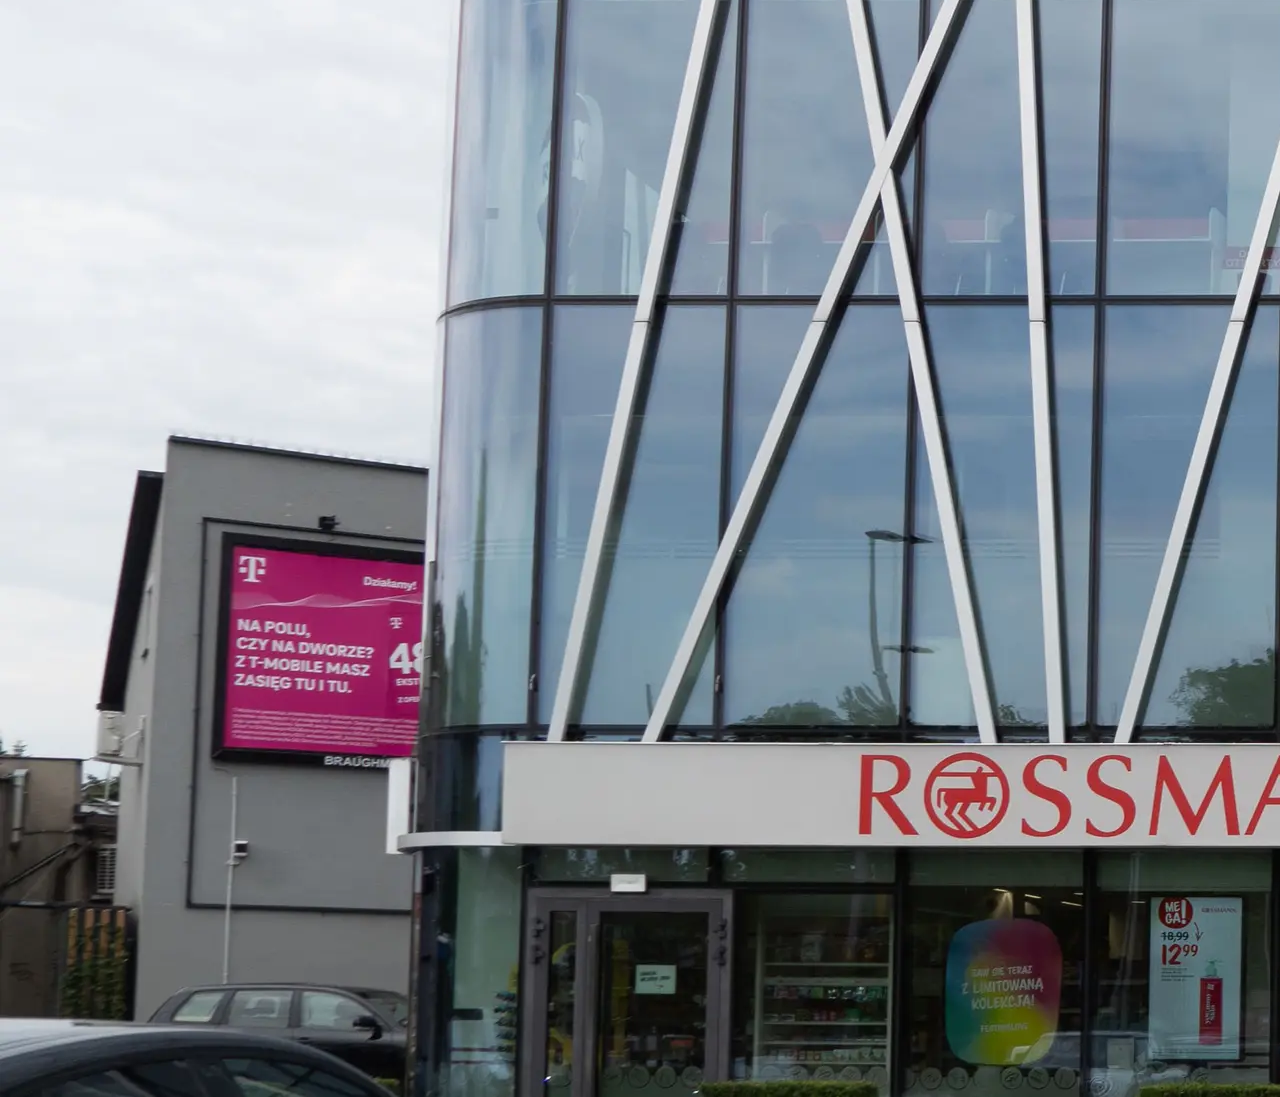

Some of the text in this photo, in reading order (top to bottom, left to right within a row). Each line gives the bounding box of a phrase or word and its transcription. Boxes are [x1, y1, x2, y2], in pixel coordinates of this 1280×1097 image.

[363, 576, 417, 591] Działamy!
[236, 619, 311, 638] NA POLU,
[236, 636, 375, 659] CZY NA DWORZE?
[234, 655, 371, 677] Z T-MOBILE MASZ
[233, 673, 353, 693] ZASIĘG TU I TU.
[961, 983, 969, 995] Z
